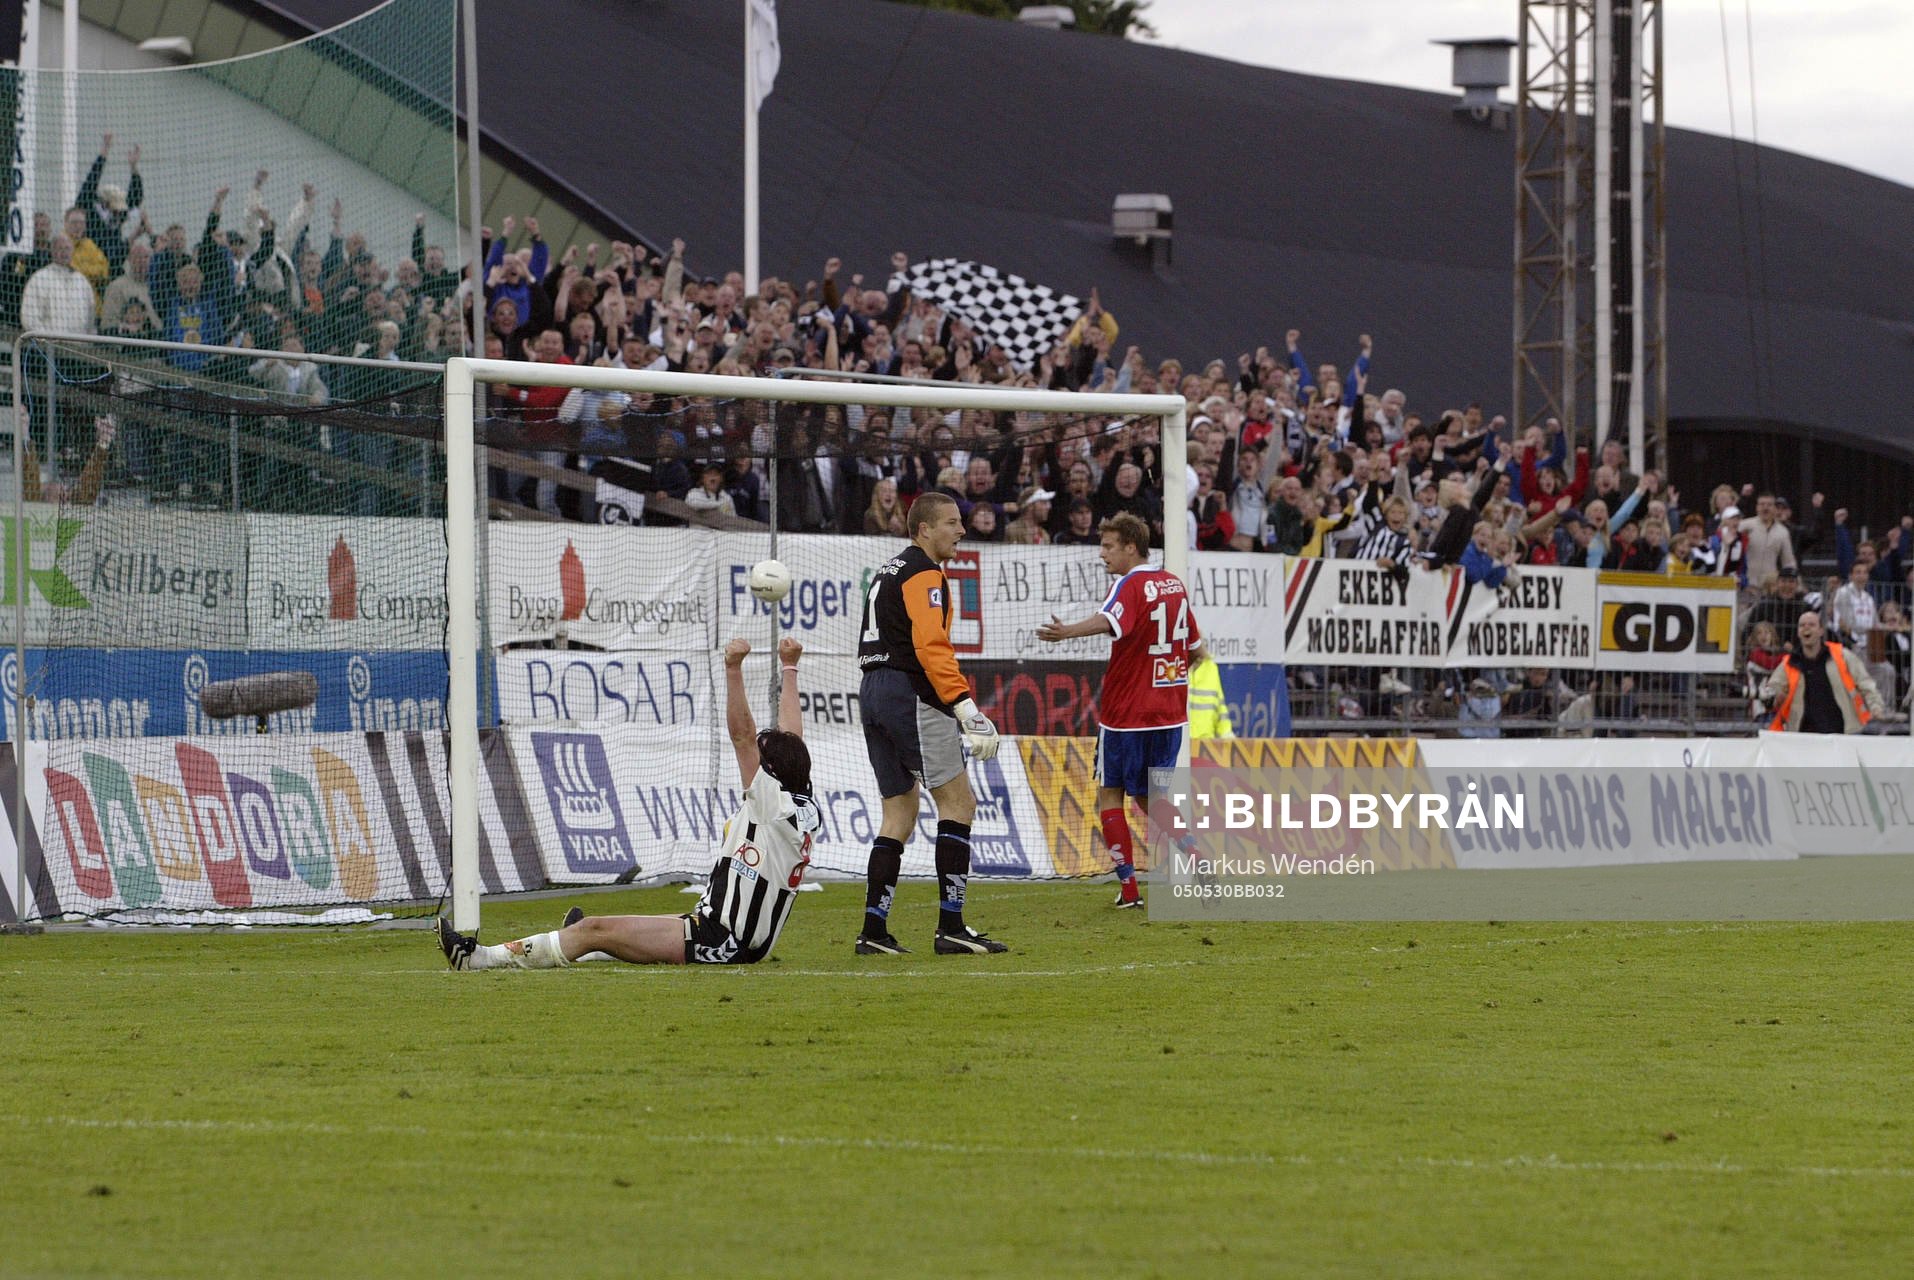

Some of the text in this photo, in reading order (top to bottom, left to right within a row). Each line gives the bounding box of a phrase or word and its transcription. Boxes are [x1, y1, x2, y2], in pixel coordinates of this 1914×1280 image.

[92, 550, 234, 609] Killbergs
[730, 565, 851, 630] Fgger
[996, 560, 1029, 601] AB
[1338, 569, 1408, 606] EKEBY
[1498, 575, 1563, 610] EKEBY
[272, 582, 448, 634] Bygg Compa
[509, 586, 708, 635] Bygg Compagniet
[863, 580, 882, 642] 1
[1148, 598, 1190, 655] 14
[1307, 609, 1440, 656] MÖBELAFFÄR
[1612, 602, 1721, 653] GDL
[1467, 614, 1591, 657] MÖBELAFFÄR
[526, 659, 696, 725] ROSAR
[1650, 747, 1773, 850] MÅLERI
[1783, 779, 1869, 828] PARTI
[61, 788, 372, 868] LANDORA
[566, 834, 628, 862] YARA
[971, 838, 1022, 865] YARA
